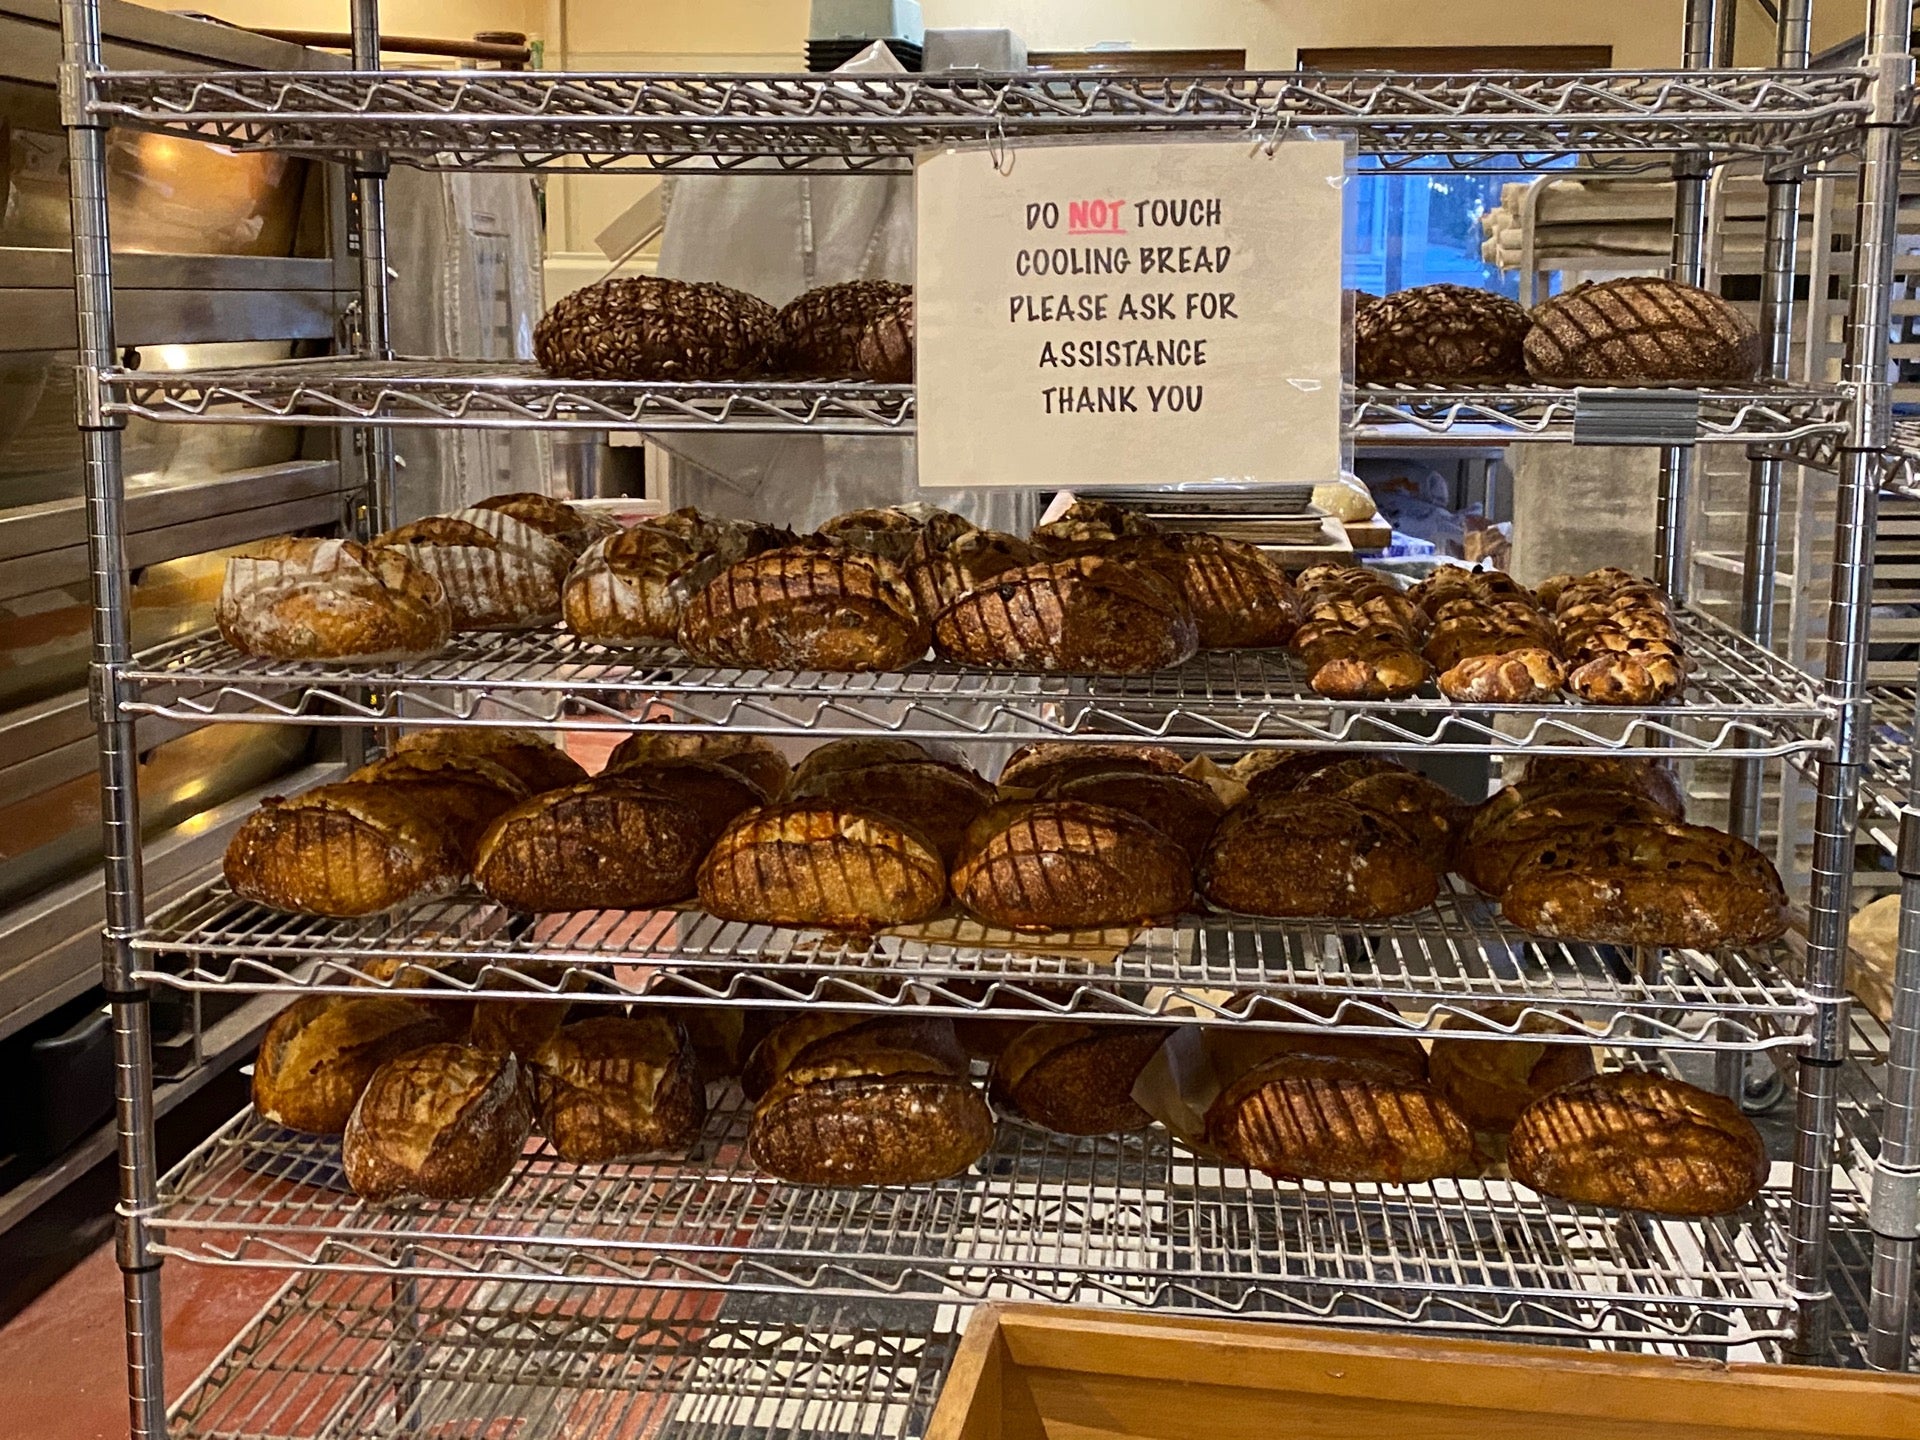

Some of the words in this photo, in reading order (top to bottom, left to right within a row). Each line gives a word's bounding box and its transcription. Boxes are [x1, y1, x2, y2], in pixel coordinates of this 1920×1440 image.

[1026, 201, 1060, 231] DO
[1068, 198, 1127, 235] NOT
[1134, 198, 1222, 228] TOUCH
[1016, 246, 1132, 277] COOLING
[1139, 245, 1232, 275] BREAD
[1009, 293, 1109, 323] PLEASE
[1117, 293, 1177, 321] ASK
[1186, 292, 1239, 320] FOR
[1039, 338, 1208, 368] ASSISTANCE
[1041, 385, 1138, 414] THANK
[1146, 385, 1204, 413] YOU
